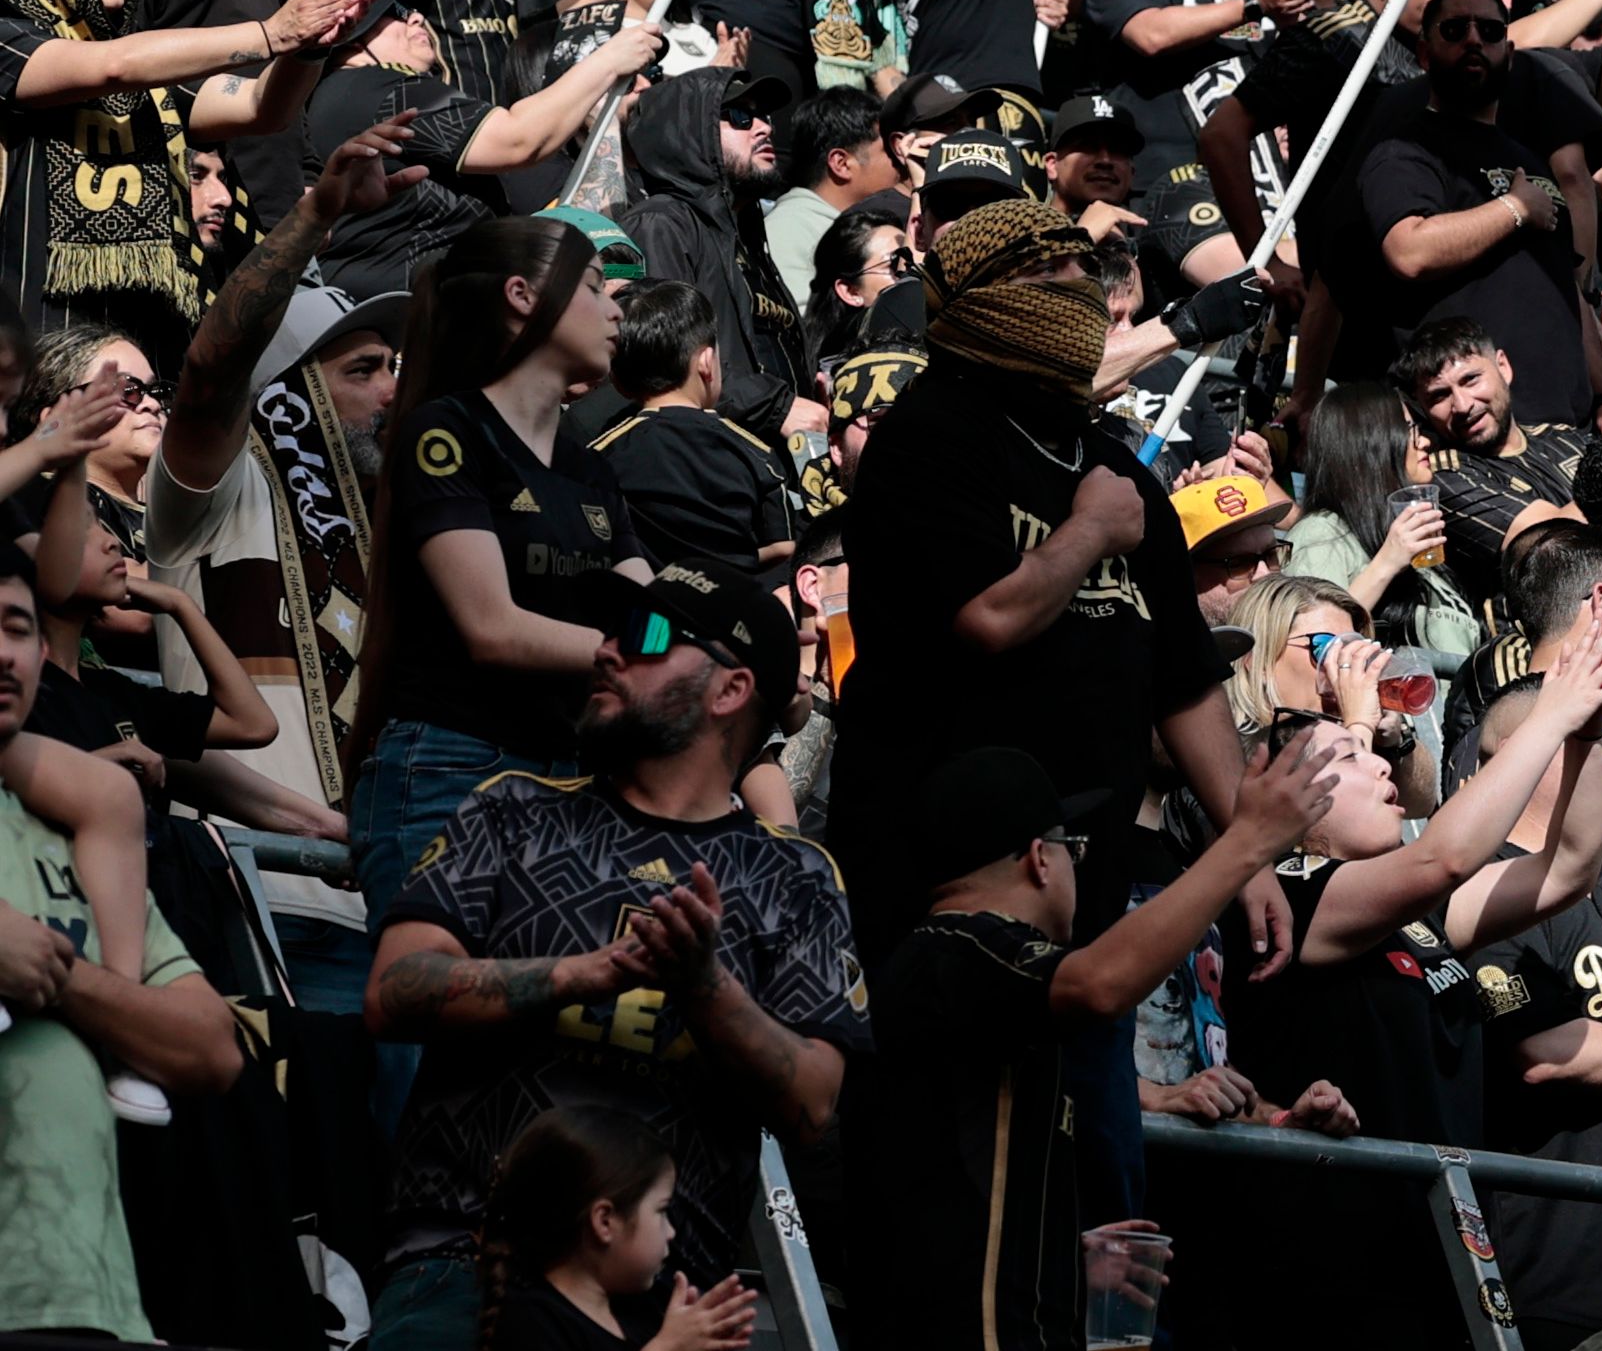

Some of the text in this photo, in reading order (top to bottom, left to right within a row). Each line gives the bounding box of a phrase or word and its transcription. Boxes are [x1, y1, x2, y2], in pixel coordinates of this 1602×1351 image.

[286, 564, 308, 634] CHAMPIONS
[303, 642, 317, 680] 2022
[309, 687, 323, 716] MLS
[314, 717, 339, 793] CHAMPIONS
